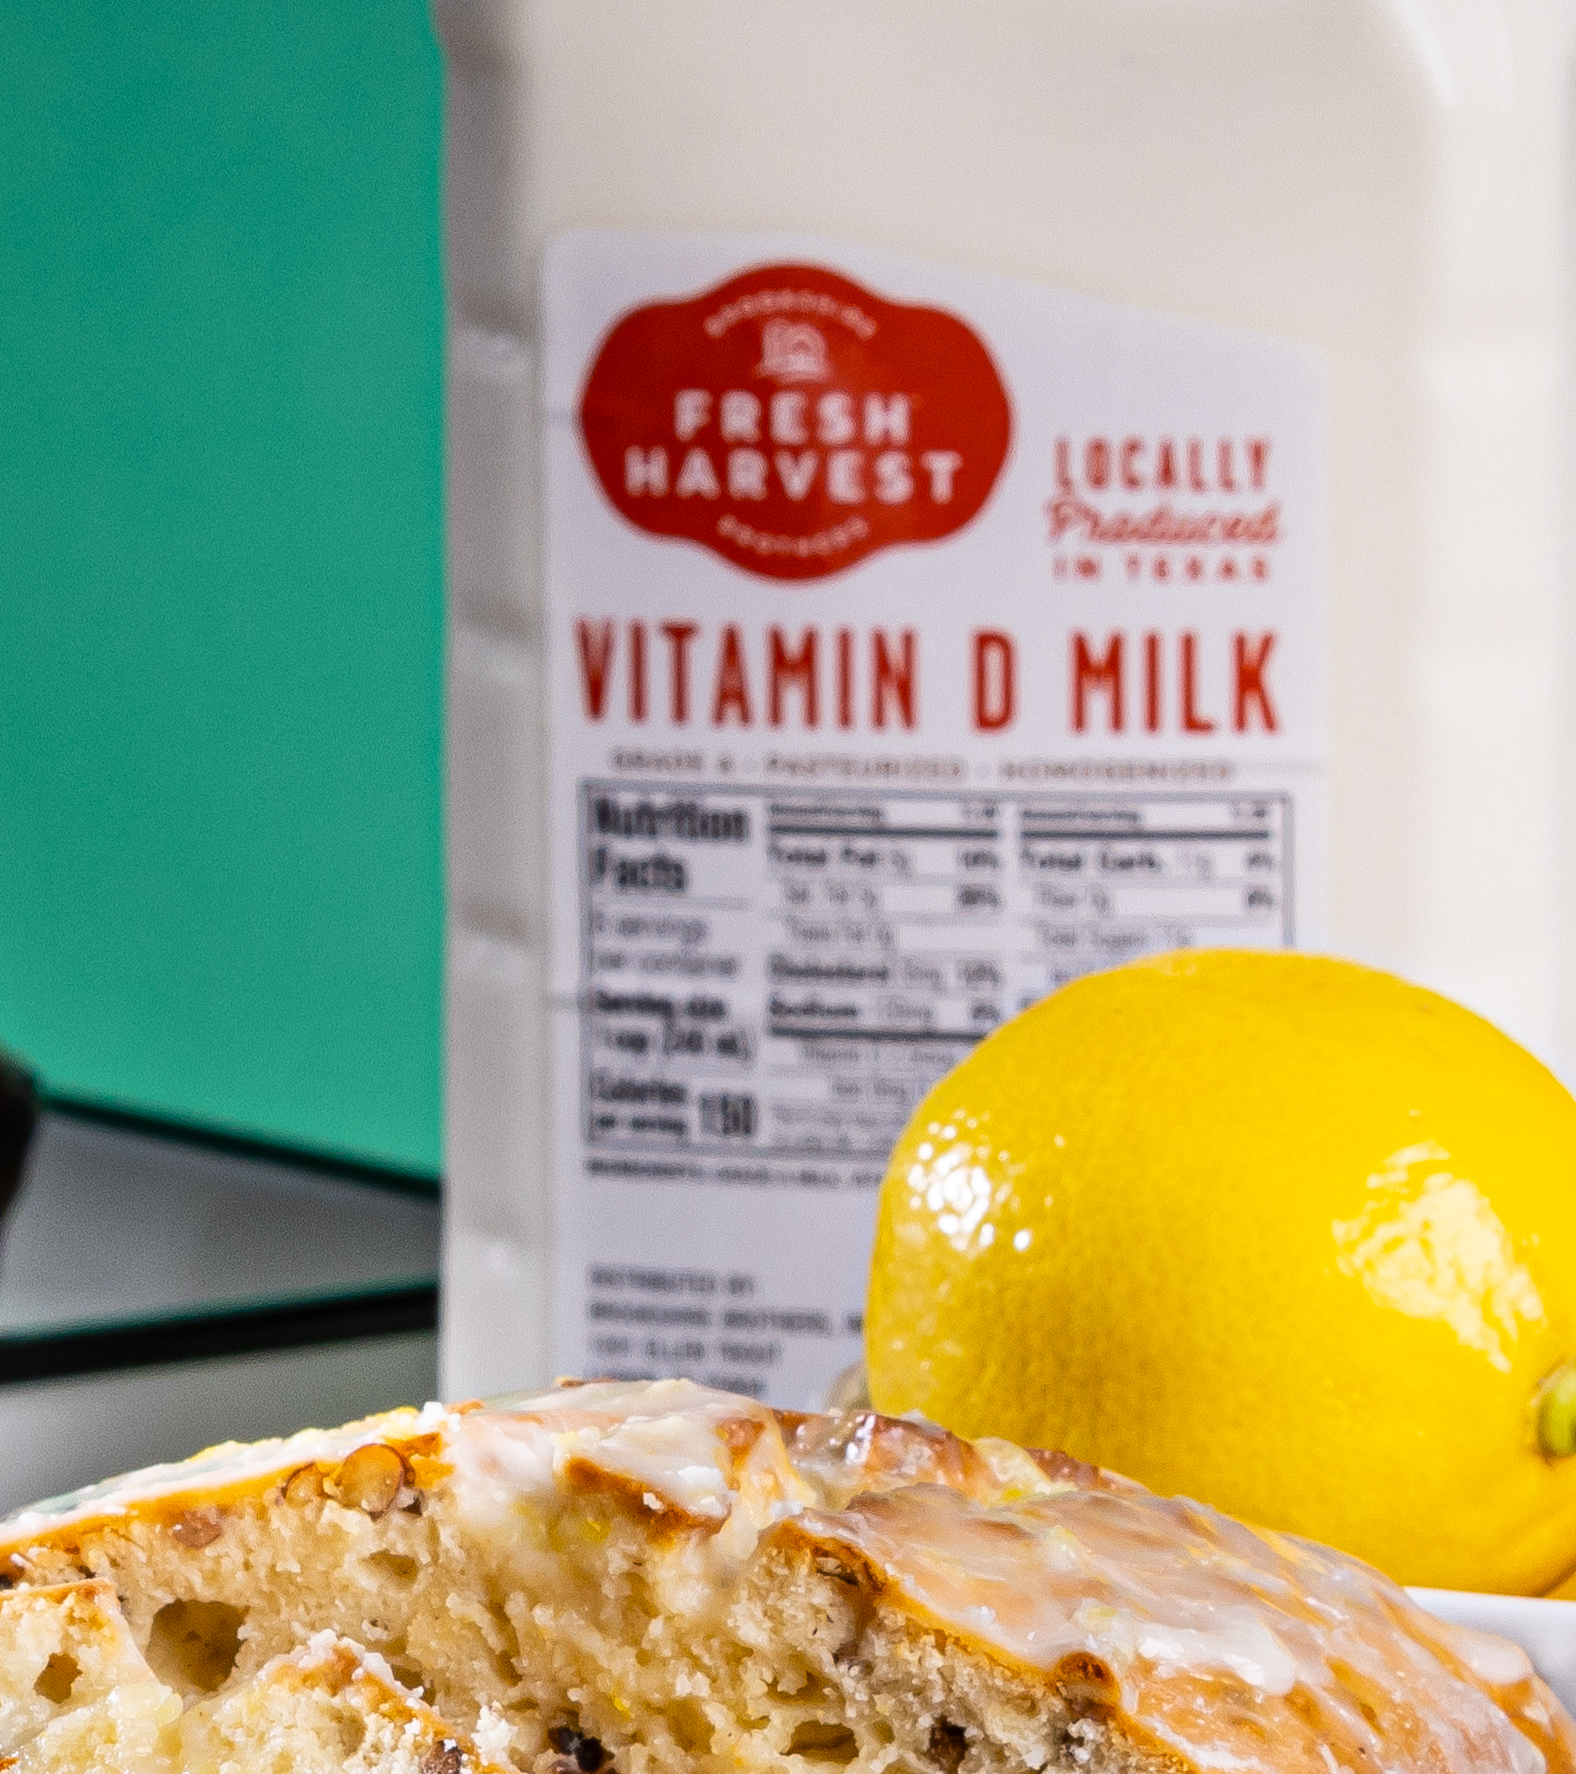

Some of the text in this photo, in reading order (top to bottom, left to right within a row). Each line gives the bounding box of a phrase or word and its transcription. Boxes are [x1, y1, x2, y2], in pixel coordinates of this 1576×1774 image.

[673, 389, 912, 446] FRESH
[623, 445, 964, 505] HARVEST
[1052, 434, 1273, 494] LOCALLY
[1043, 496, 1283, 547] Produced
[575, 617, 1281, 737] VITAMIN D MILK
[593, 800, 748, 840] Nutrition
[593, 844, 687, 891] Facts
